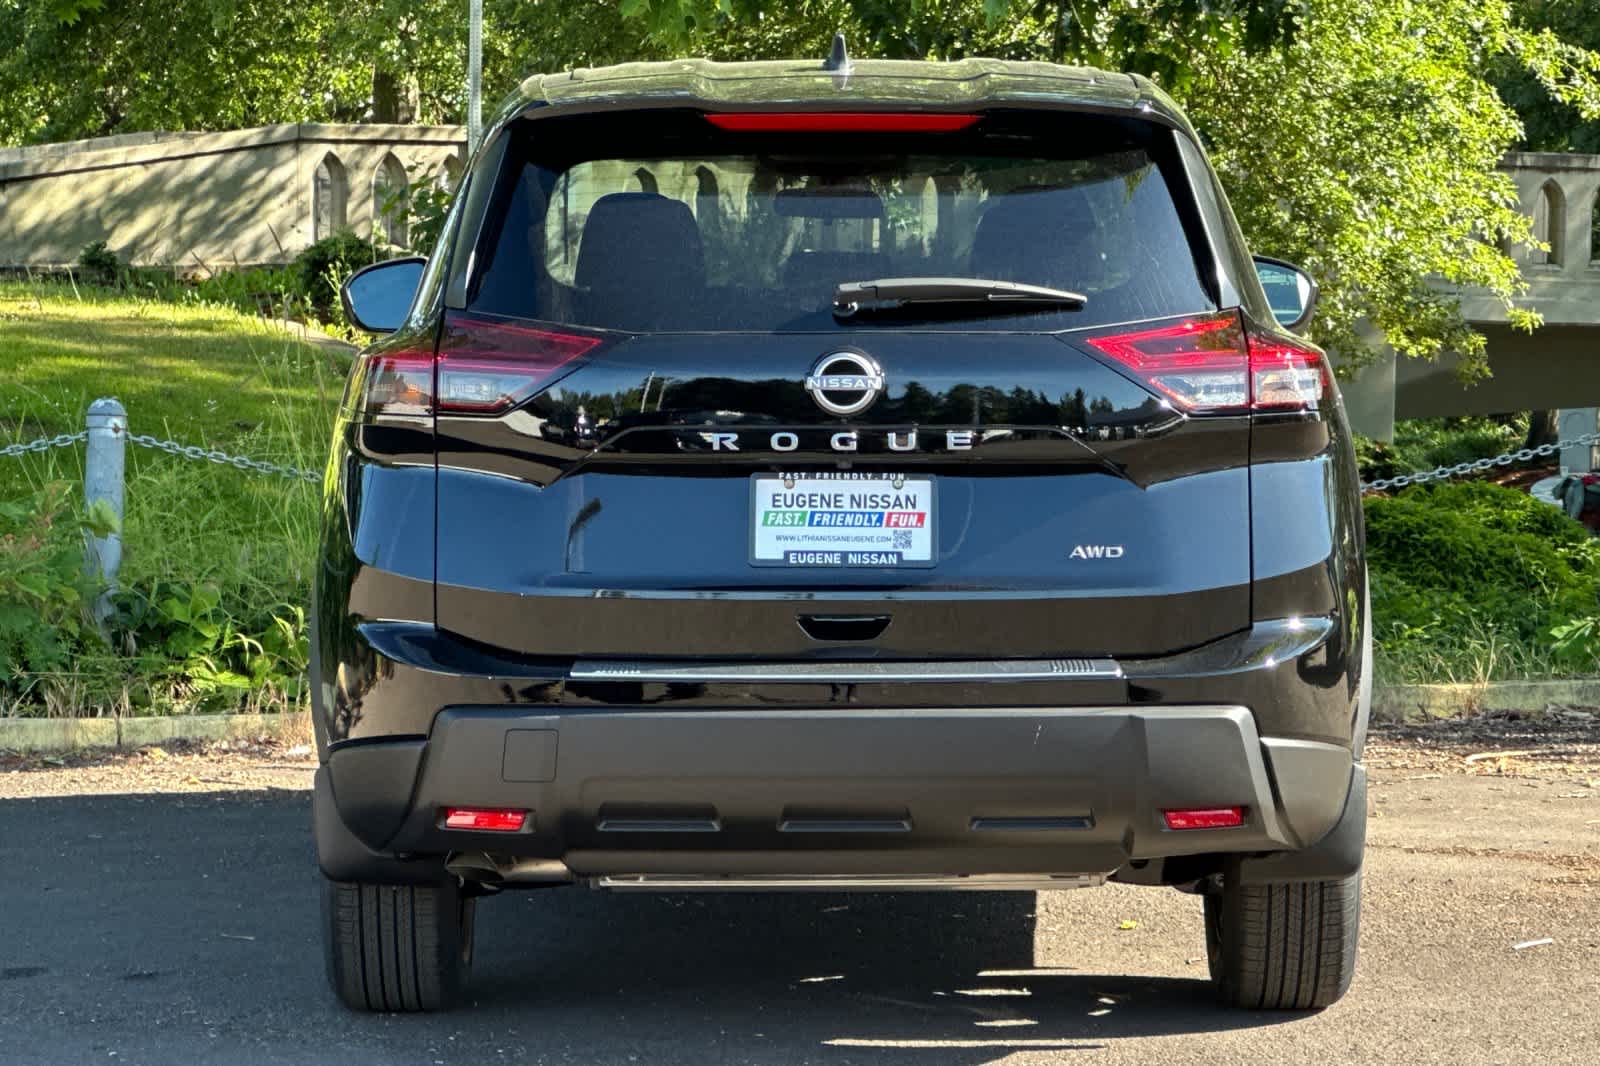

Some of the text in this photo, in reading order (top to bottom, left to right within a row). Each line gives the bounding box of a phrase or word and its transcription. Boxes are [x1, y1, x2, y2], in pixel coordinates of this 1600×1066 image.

[807, 376, 882, 390] NISSAN
[711, 432, 974, 451] ROGUE
[771, 493, 917, 510] EUGENE NISSAN
[767, 512, 922, 527] FAST. FRIENDLY. FUN.
[789, 553, 897, 564] EUGENE NISSAN
[1069, 545, 1124, 559] AWD
